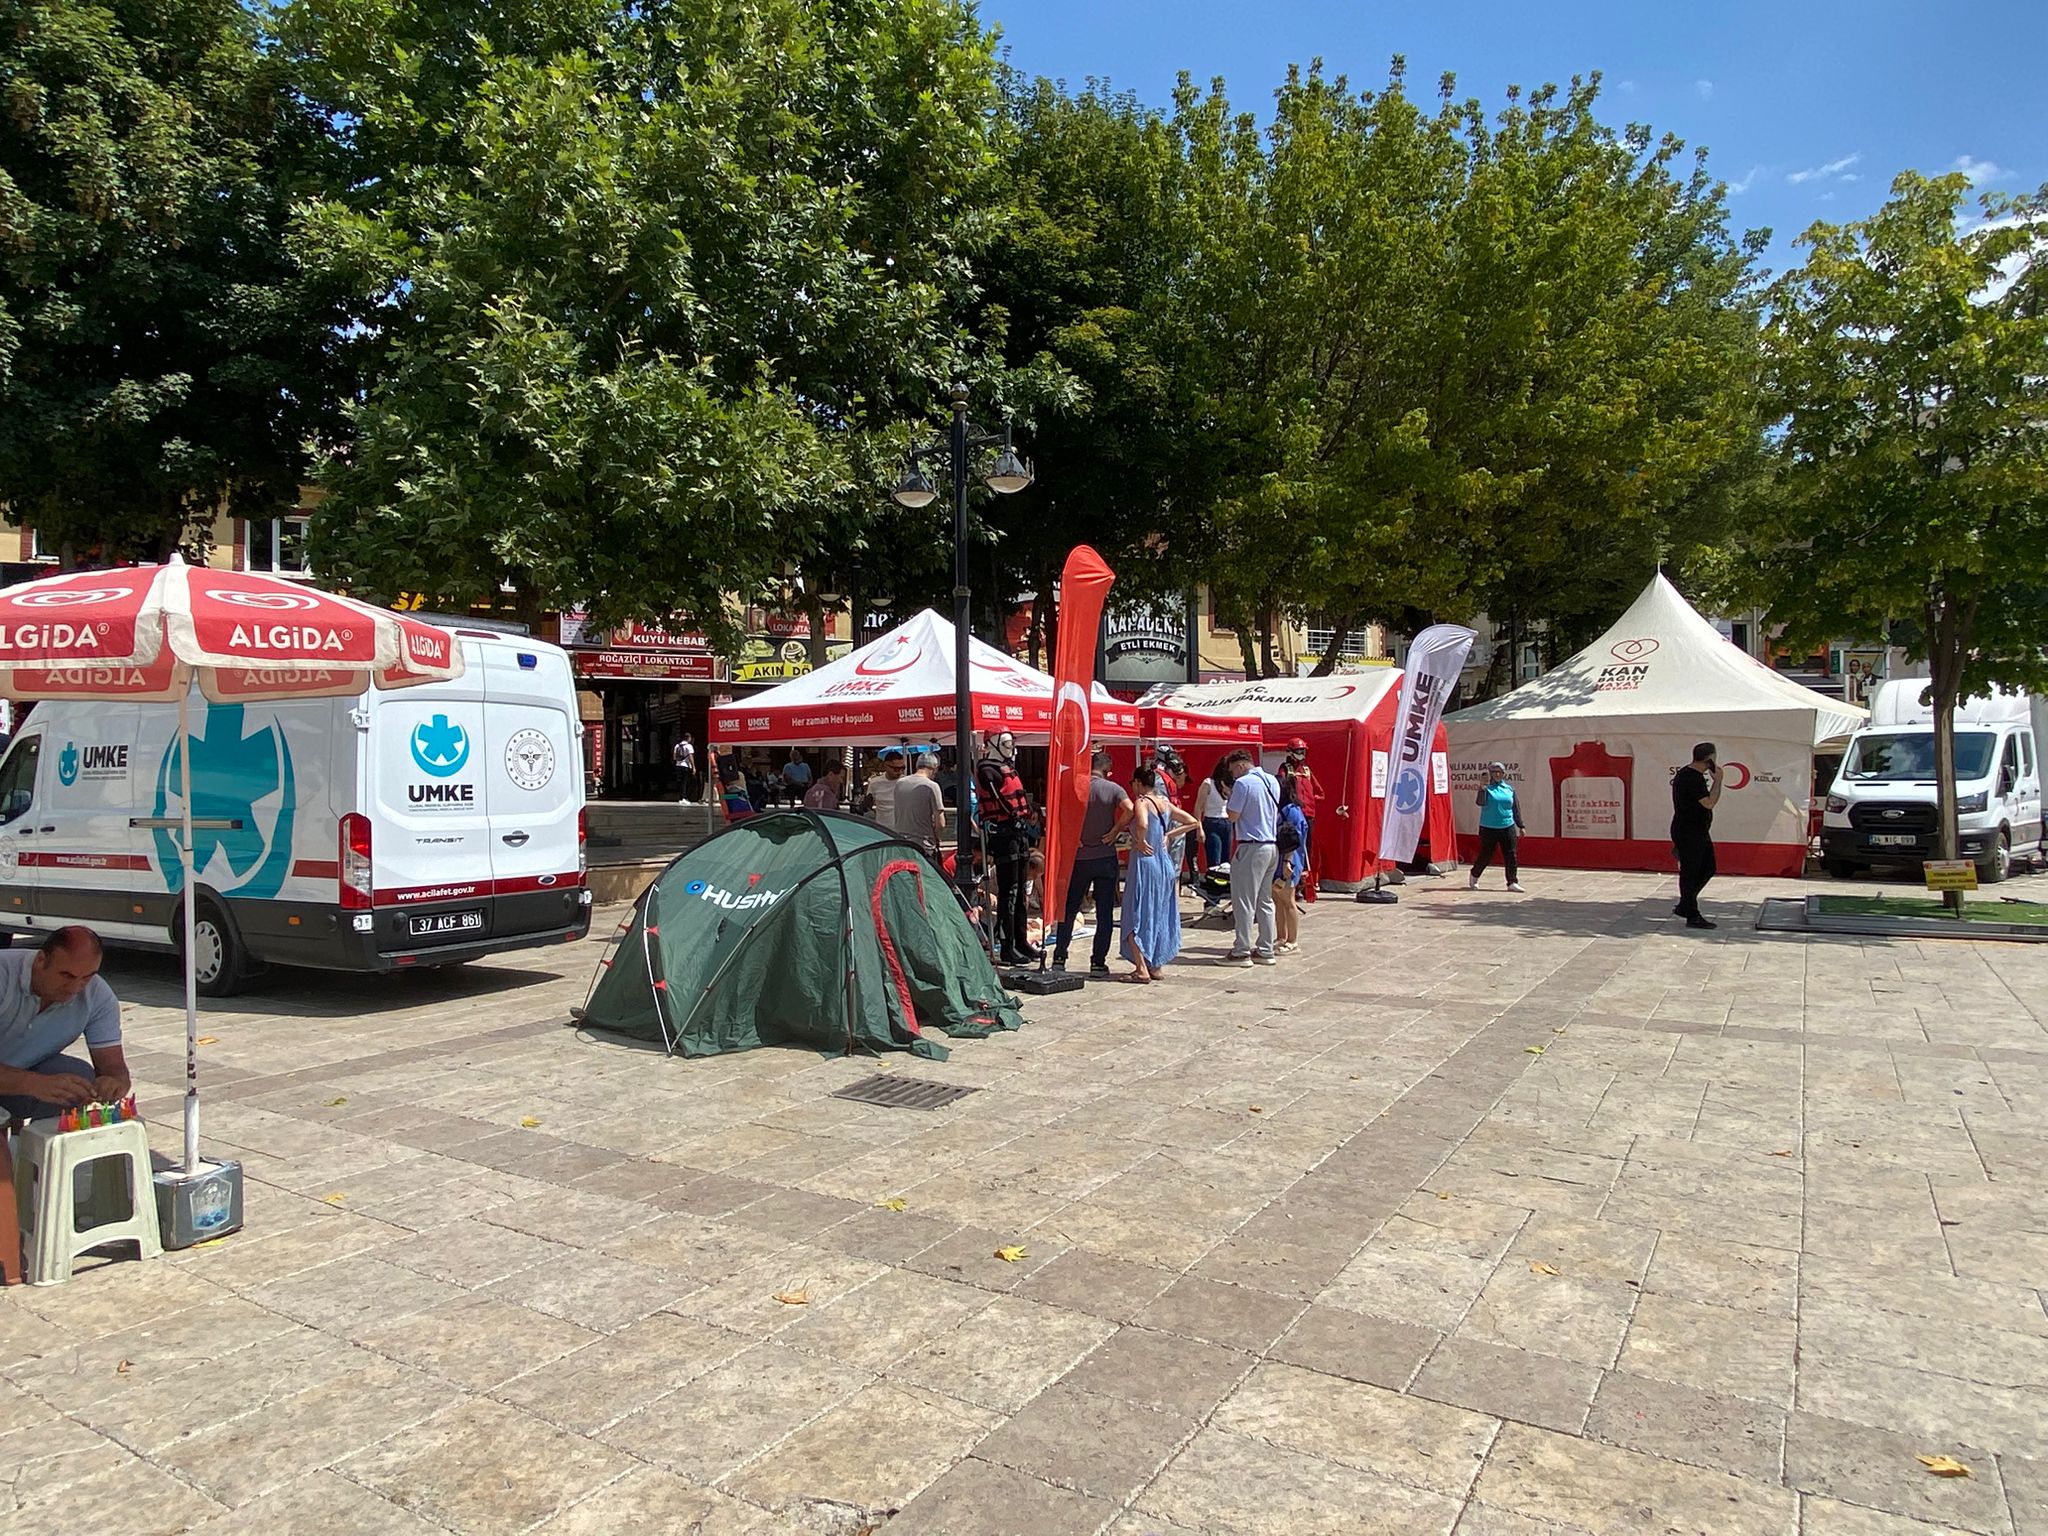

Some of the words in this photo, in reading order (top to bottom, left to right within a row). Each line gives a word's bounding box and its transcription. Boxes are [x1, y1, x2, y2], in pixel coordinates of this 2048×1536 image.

[0, 624, 98, 649] LGiDA
[229, 623, 344, 651] ALGiDA
[633, 634, 665, 645] KUYU
[411, 634, 442, 659] ALGiDA
[1120, 639, 1140, 651] ETLİ
[1142, 640, 1176, 653] EKMEK
[645, 654, 693, 666] LOKANTASI
[753, 666, 785, 677] AKIN
[1600, 665, 1649, 677] KAN
[1184, 697, 1236, 709] SAĞLIK
[1233, 693, 1318, 704] BAKANLIĞI
[791, 717, 804, 726] Her
[806, 717, 829, 726] zaman
[830, 714, 843, 724] Her
[844, 712, 873, 725] koşulda
[898, 707, 924, 719] UMKE
[1402, 671, 1434, 763] UMKE
[718, 719, 740, 728] UMKE
[747, 717, 770, 726] UMKE
[82, 744, 129, 769] UMKE
[408, 784, 474, 803] UMKE
[415, 836, 465, 844] TRANSIT
[397, 886, 476, 901] www.acilafet.gov.tr
[419, 918, 432, 931] 37
[437, 915, 456, 930] ACF
[461, 913, 479, 927] 861
